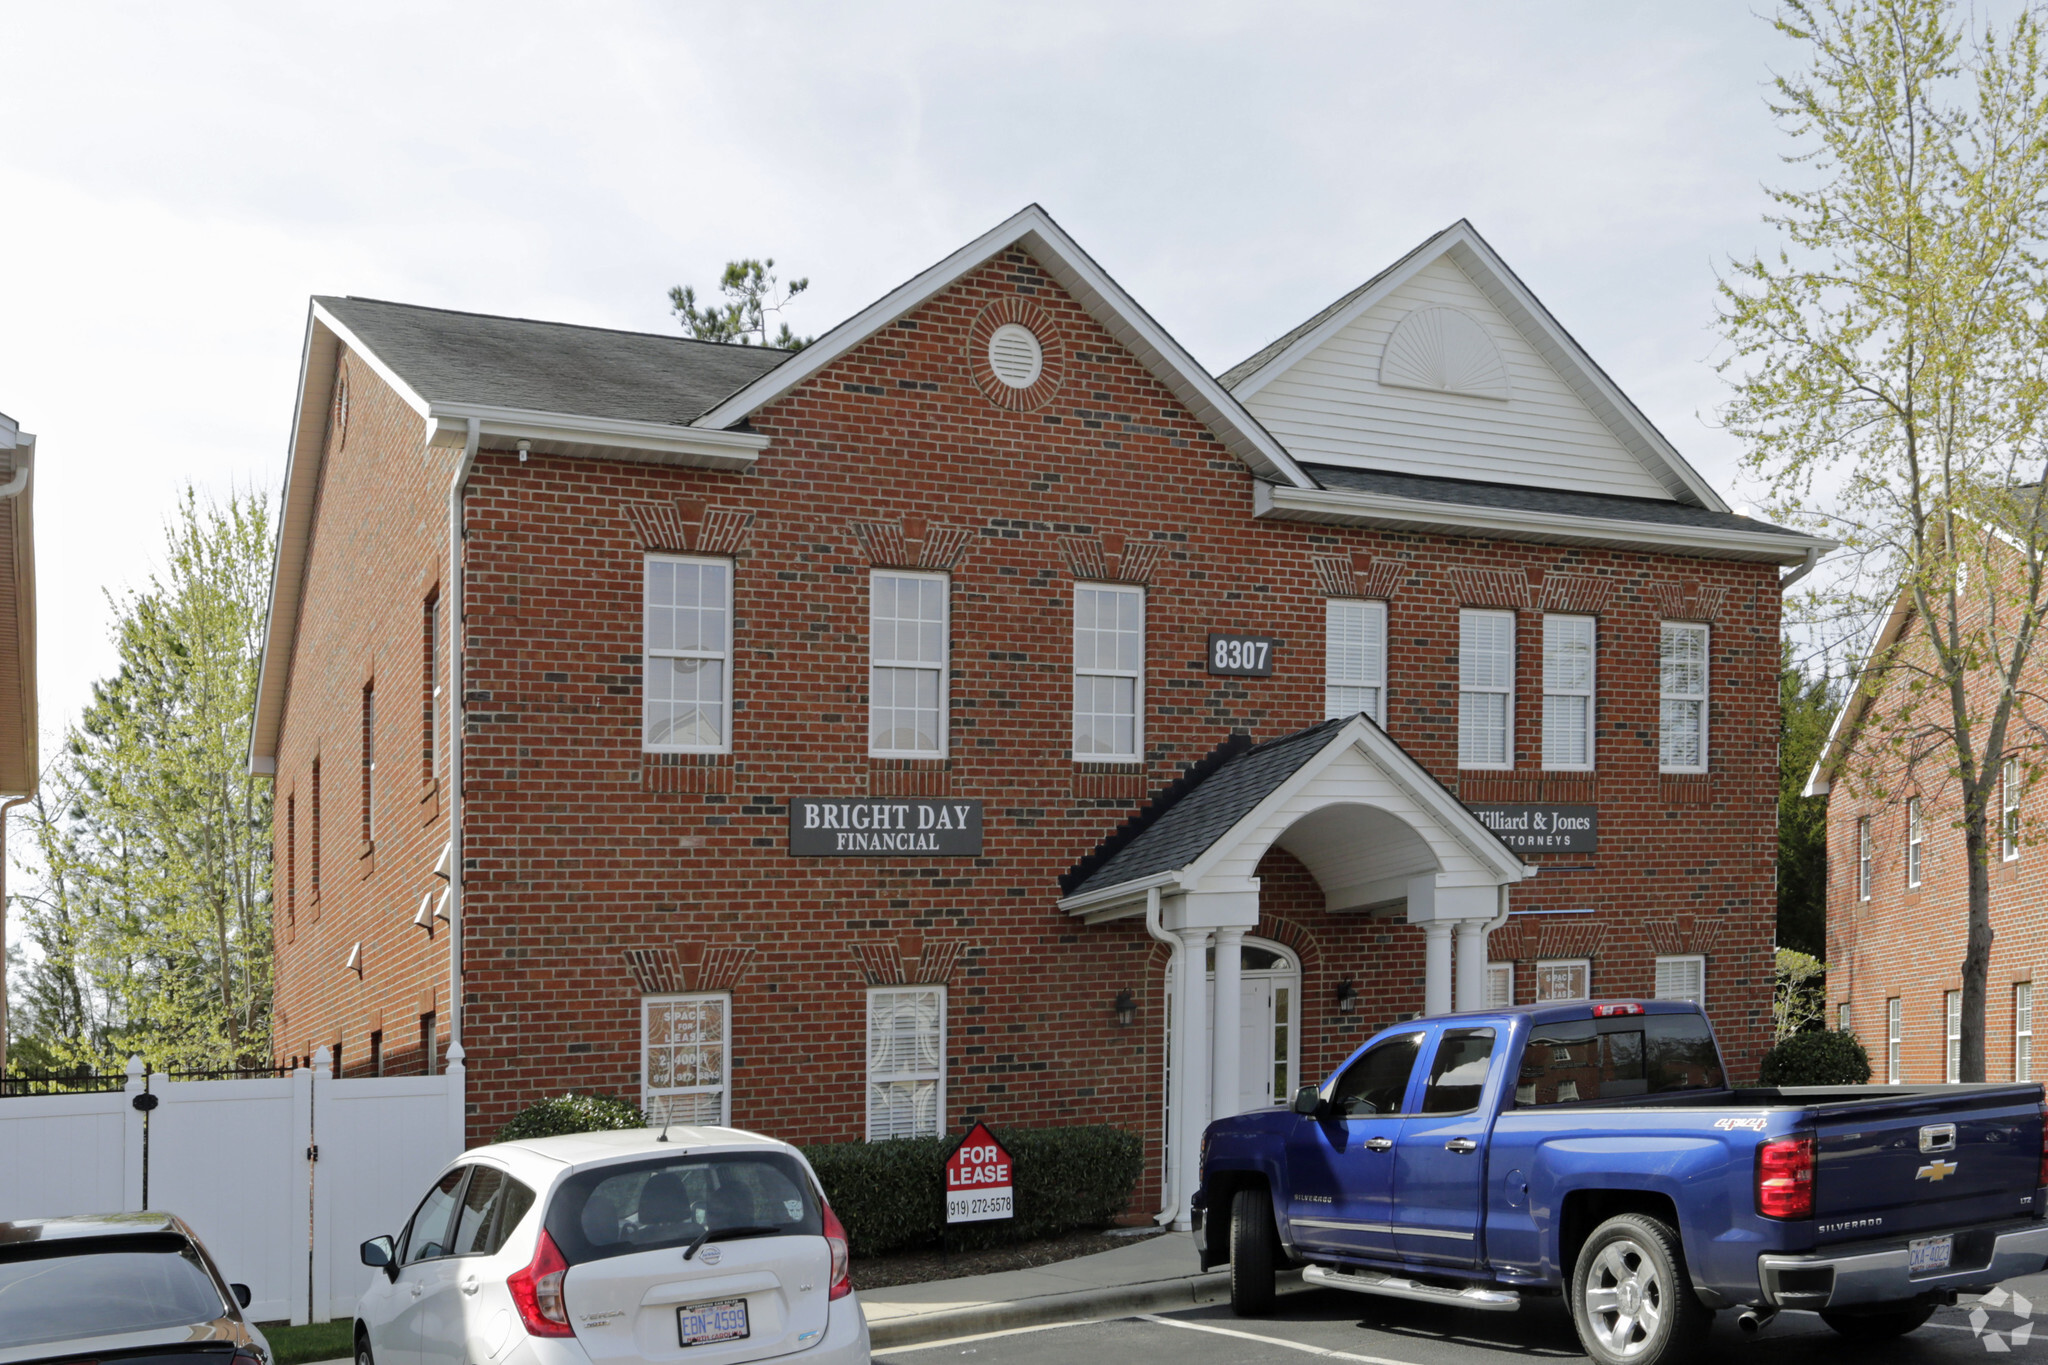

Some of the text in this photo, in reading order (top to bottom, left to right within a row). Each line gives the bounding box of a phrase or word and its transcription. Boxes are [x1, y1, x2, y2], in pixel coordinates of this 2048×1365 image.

[1215, 639, 1269, 670] 8307
[804, 803, 970, 830] BRIGHT DAY
[1533, 812, 1548, 830] &
[1551, 812, 1590, 834] Jones
[836, 832, 940, 851] FINANCIAL
[1501, 835, 1571, 846] TTORNEYS
[1545, 973, 1574, 982] SPACE
[1545, 990, 1574, 999] LEASE
[663, 1010, 706, 1022] SPACE
[677, 1023, 694, 1031] FOR
[664, 1032, 707, 1043] LEASE
[960, 1145, 997, 1165] FOR
[949, 1164, 1008, 1186] LEASE
[947, 1196, 1012, 1219] (919) 272-5578
[1294, 1193, 1332, 1204] SILVERADO
[1818, 1217, 1882, 1234] SILVERADO
[682, 1309, 746, 1336] EBN-4599
